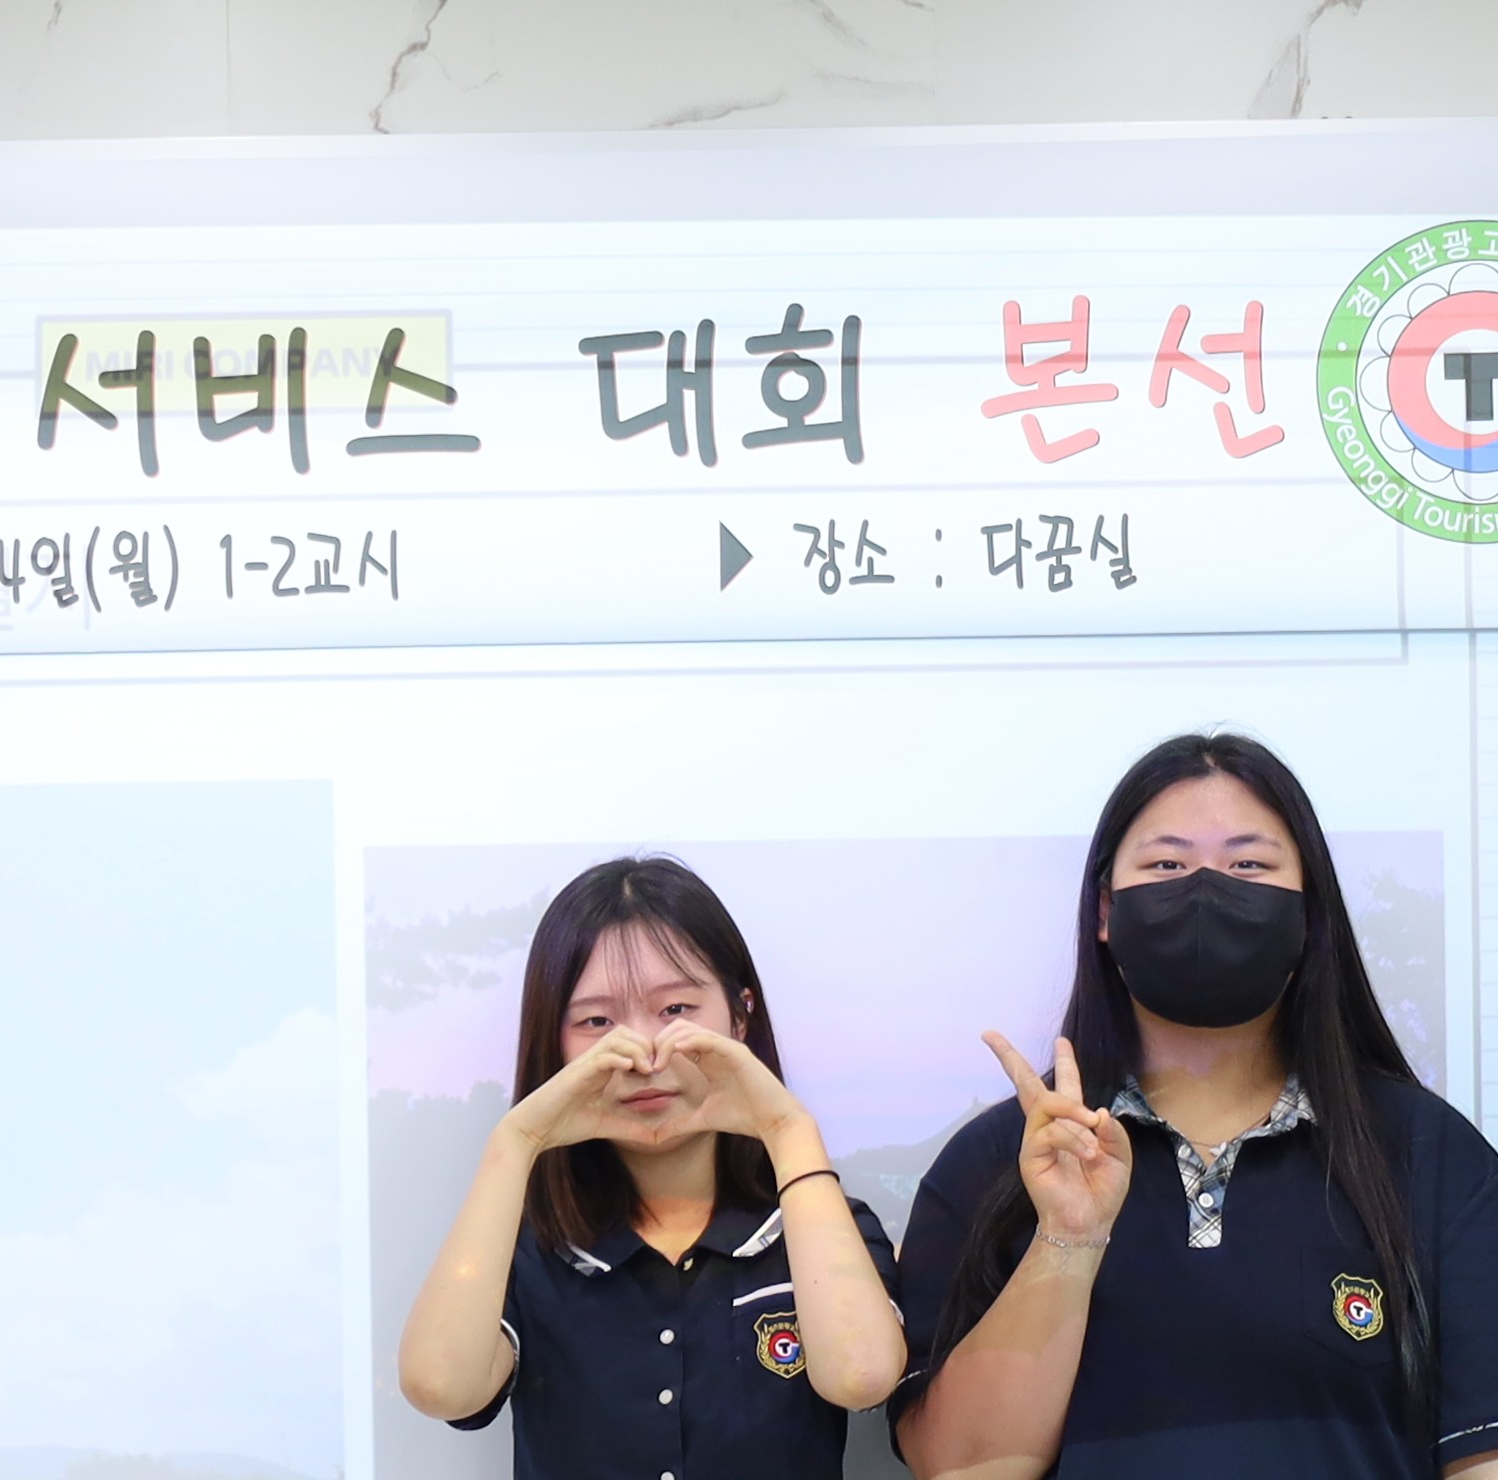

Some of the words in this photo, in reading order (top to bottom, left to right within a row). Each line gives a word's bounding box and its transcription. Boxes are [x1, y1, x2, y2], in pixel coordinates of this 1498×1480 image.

[37, 326, 481, 477] 서비스
[578, 302, 864, 467] 대회
[981, 295, 1285, 463] 본선
[1322, 386, 1413, 510] Gyeonggi
[218, 530, 400, 600] 1-2교시
[793, 519, 896, 595] 장소
[980, 513, 1139, 593] 다꿈실
